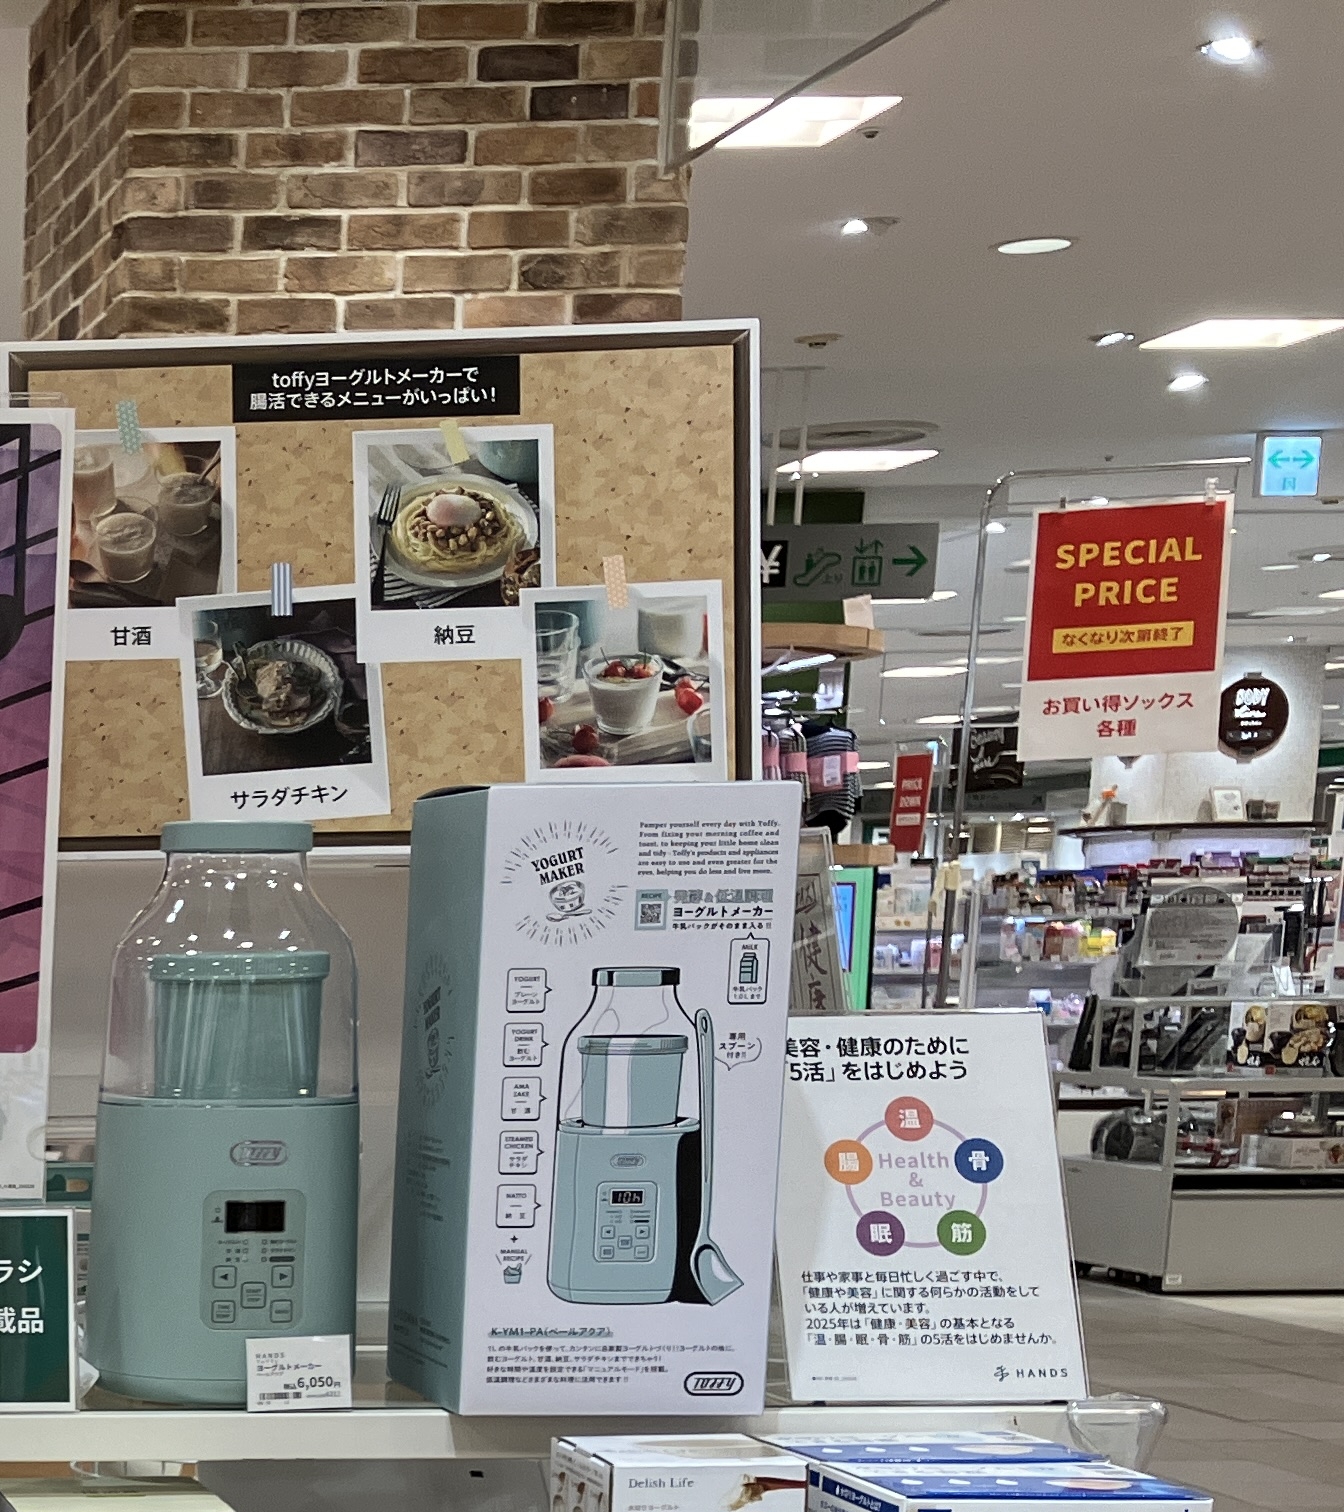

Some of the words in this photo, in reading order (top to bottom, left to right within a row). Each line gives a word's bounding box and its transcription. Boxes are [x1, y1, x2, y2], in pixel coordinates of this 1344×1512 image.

[272, 365, 479, 391] toffyヨーグルトメーカーで
[250, 387, 497, 410] 腸活できるメニューがいっぱい!
[1056, 537, 1202, 570] SPECIAL
[1074, 578, 1178, 608] PRICE
[110, 625, 152, 647] 甘酒
[434, 625, 476, 646] 納豆
[1062, 625, 1185, 648] なくなり次第終了
[1042, 692, 1194, 716] お買い得ソックス
[1096, 719, 1137, 738] 各種
[230, 783, 349, 809] サラダチキン
[531, 847, 583, 871] YOGURT
[539, 862, 585, 885] MAKER
[673, 906, 773, 917] ヨーグルトメーカー
[719, 1042, 755, 1050] スプーン
[899, 1109, 921, 1128] 温
[839, 1152, 858, 1172] 腸
[879, 1152, 949, 1168] Health
[969, 1151, 989, 1171] 骨
[909, 1173, 923, 1187] &
[881, 1192, 955, 1210] Beauty
[870, 1224, 892, 1243] 眠
[951, 1223, 972, 1243] 筋
[802, 1271, 1003, 1284] 仕事や家事と毎日忙しく過ごす中で、
[805, 1302, 931, 1314] いる人が増えています。
[1016, 1367, 1068, 1378] HANDS
[628, 1478, 666, 1488] Delish
[670, 1477, 694, 1488] Life
